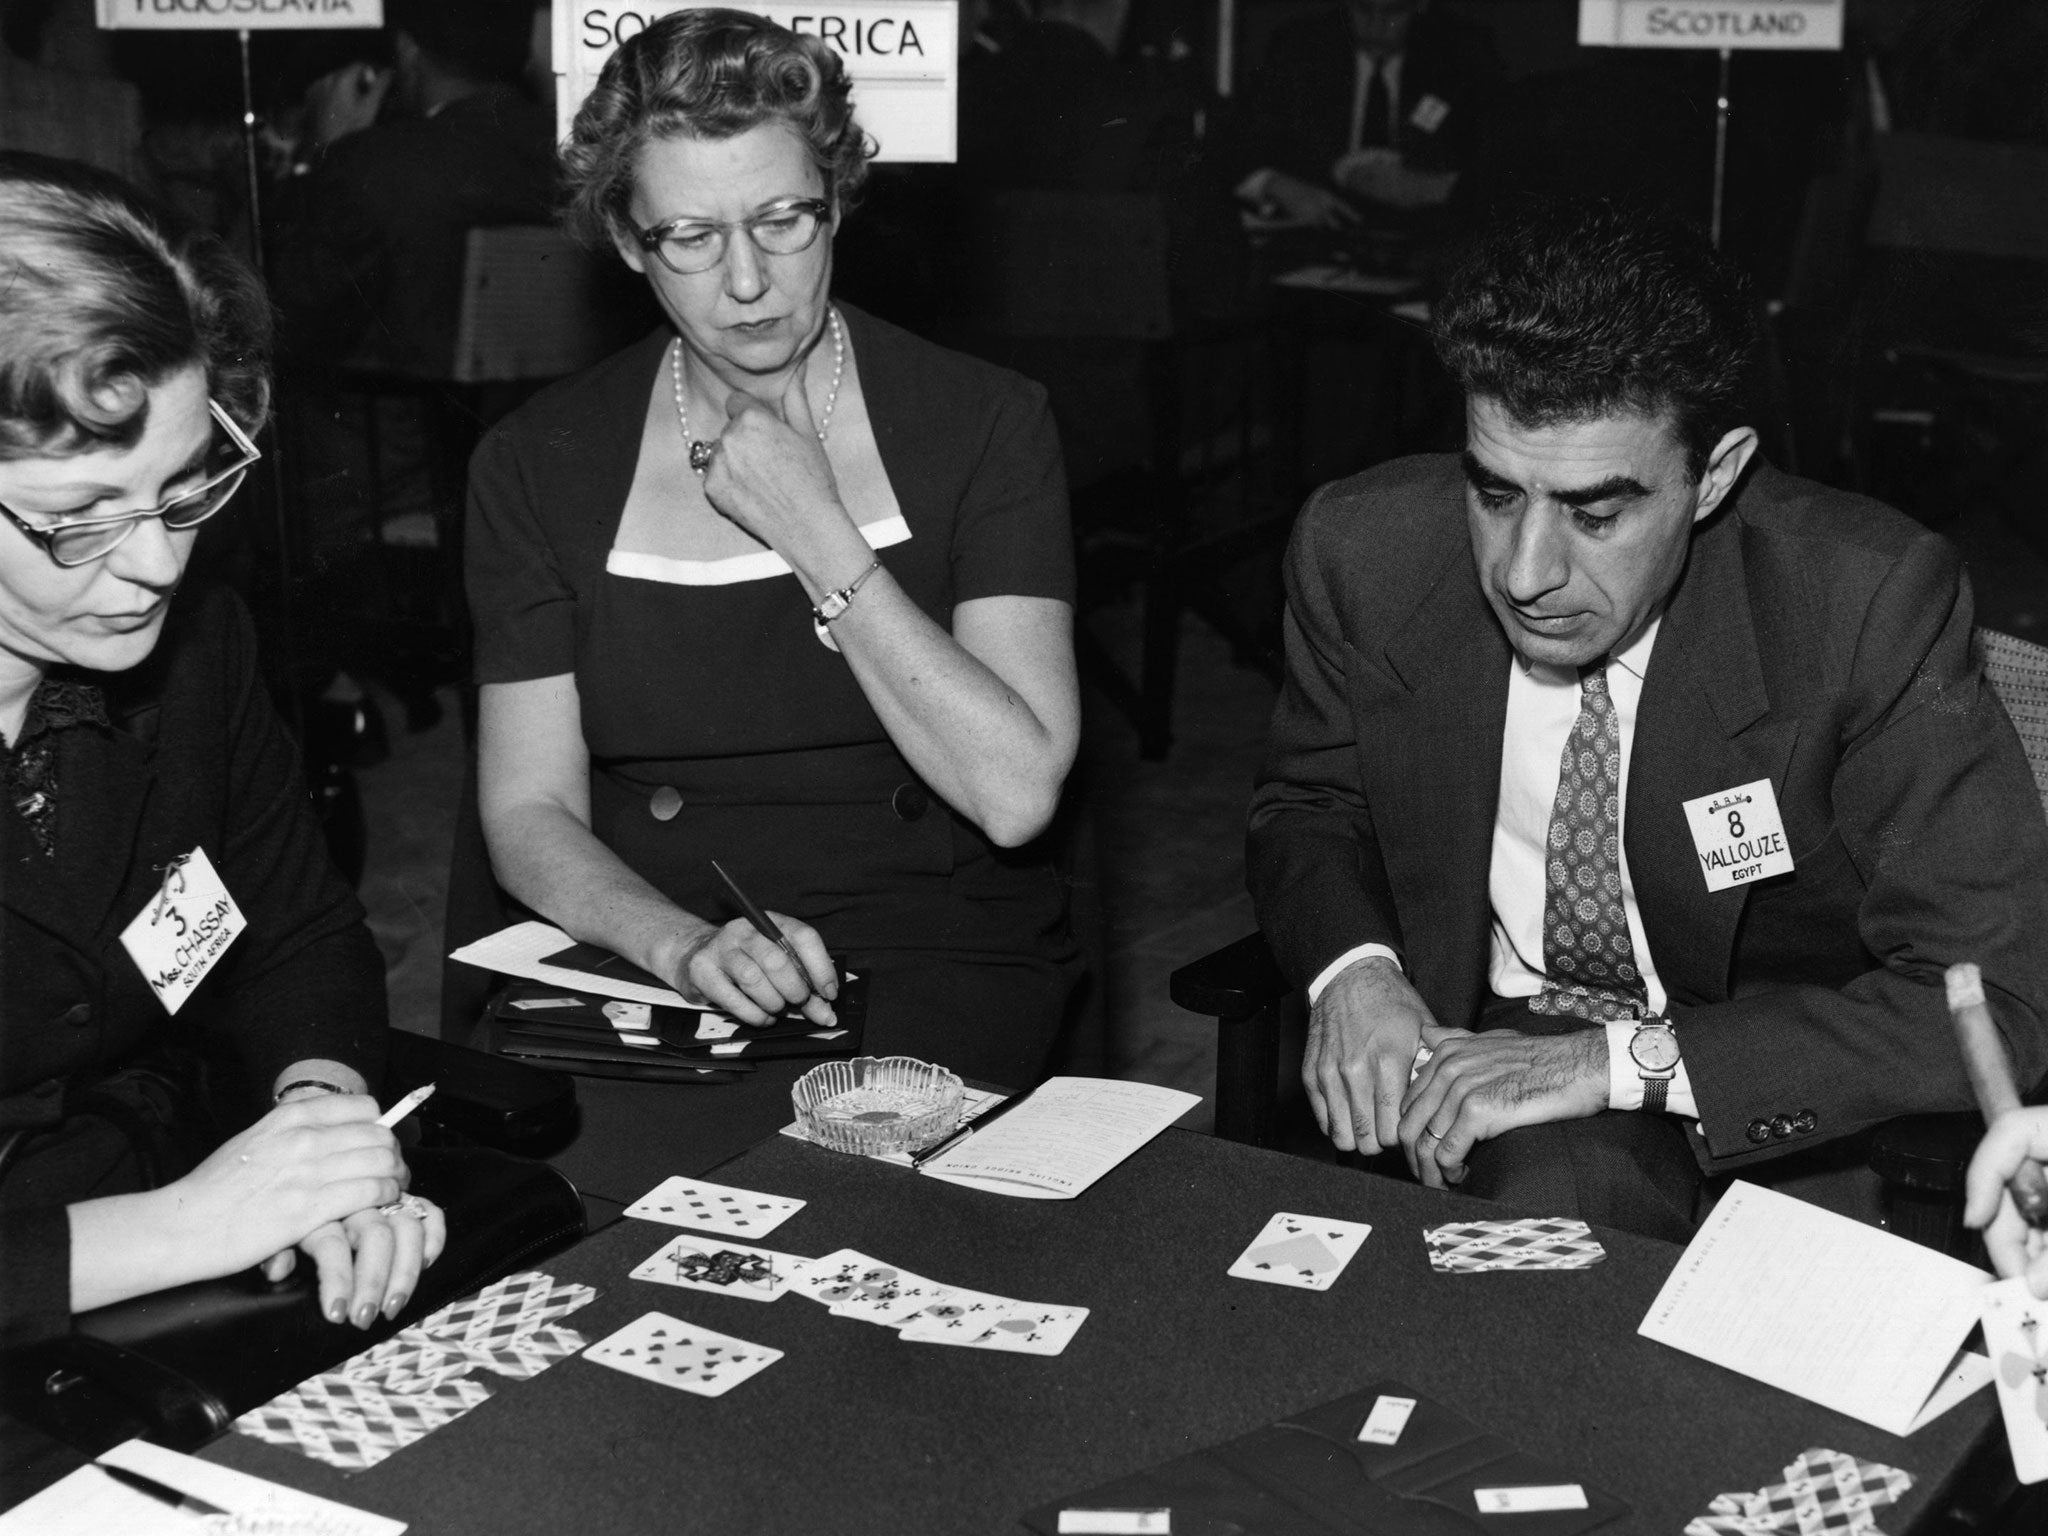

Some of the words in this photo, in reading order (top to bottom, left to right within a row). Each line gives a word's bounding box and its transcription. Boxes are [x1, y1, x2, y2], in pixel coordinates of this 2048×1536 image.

[765, 15, 924, 56] FRICA
[1727, 810, 1745, 838] 8
[1699, 832, 1785, 871] YALLOUZE
[1732, 863, 1762, 881] EGYPT
[165, 905, 187, 937] 3
[175, 893, 231, 968] CHASSAY
[183, 955, 207, 989] SOUTH
[206, 926, 232, 957] AFRICA
